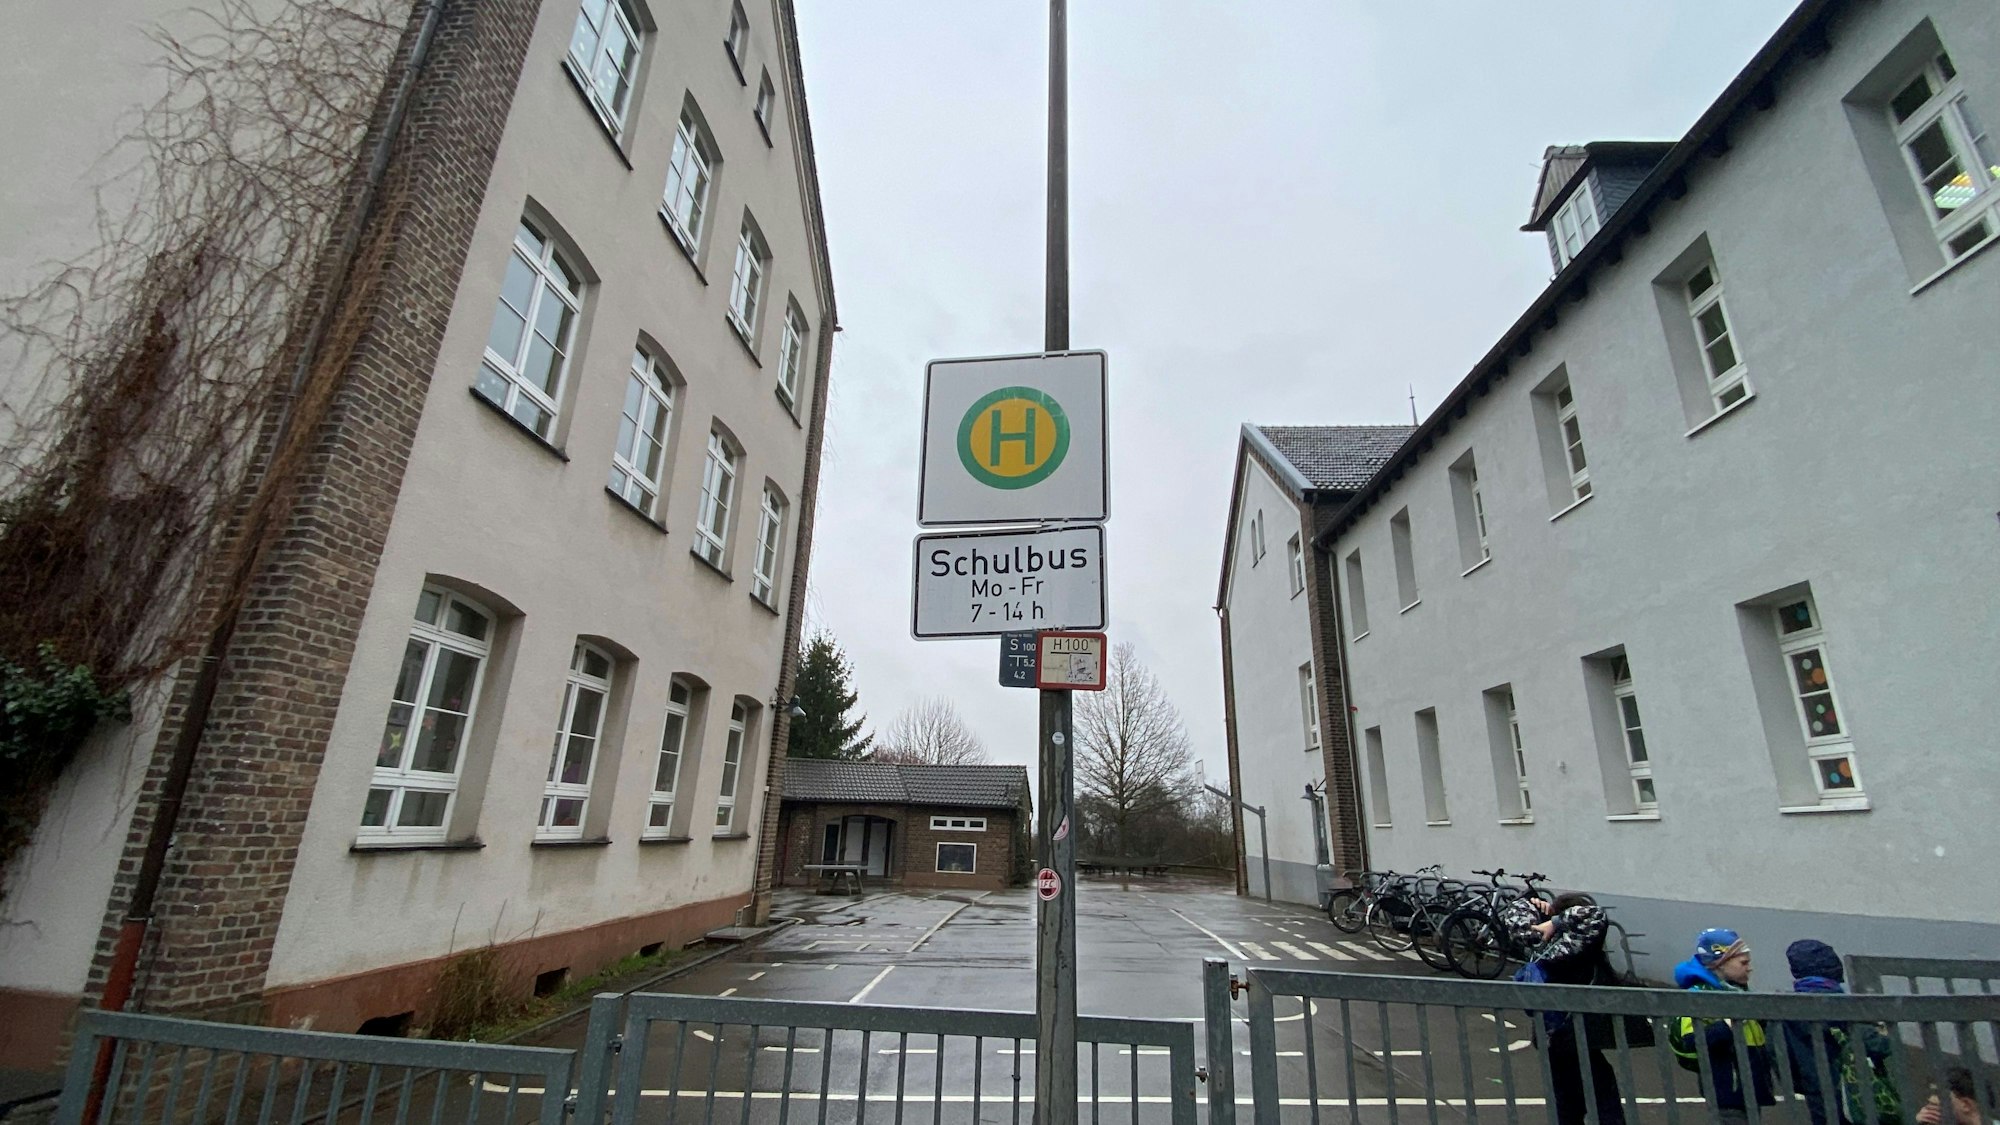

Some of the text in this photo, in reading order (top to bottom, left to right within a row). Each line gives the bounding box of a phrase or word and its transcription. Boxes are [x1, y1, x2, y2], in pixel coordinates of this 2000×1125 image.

[990, 407, 1036, 467] H
[930, 545, 1087, 577] Schulbus
[1032, 600, 1044, 620] h
[1010, 638, 1037, 652] S 100
[1013, 670, 1026, 680] 4.2
